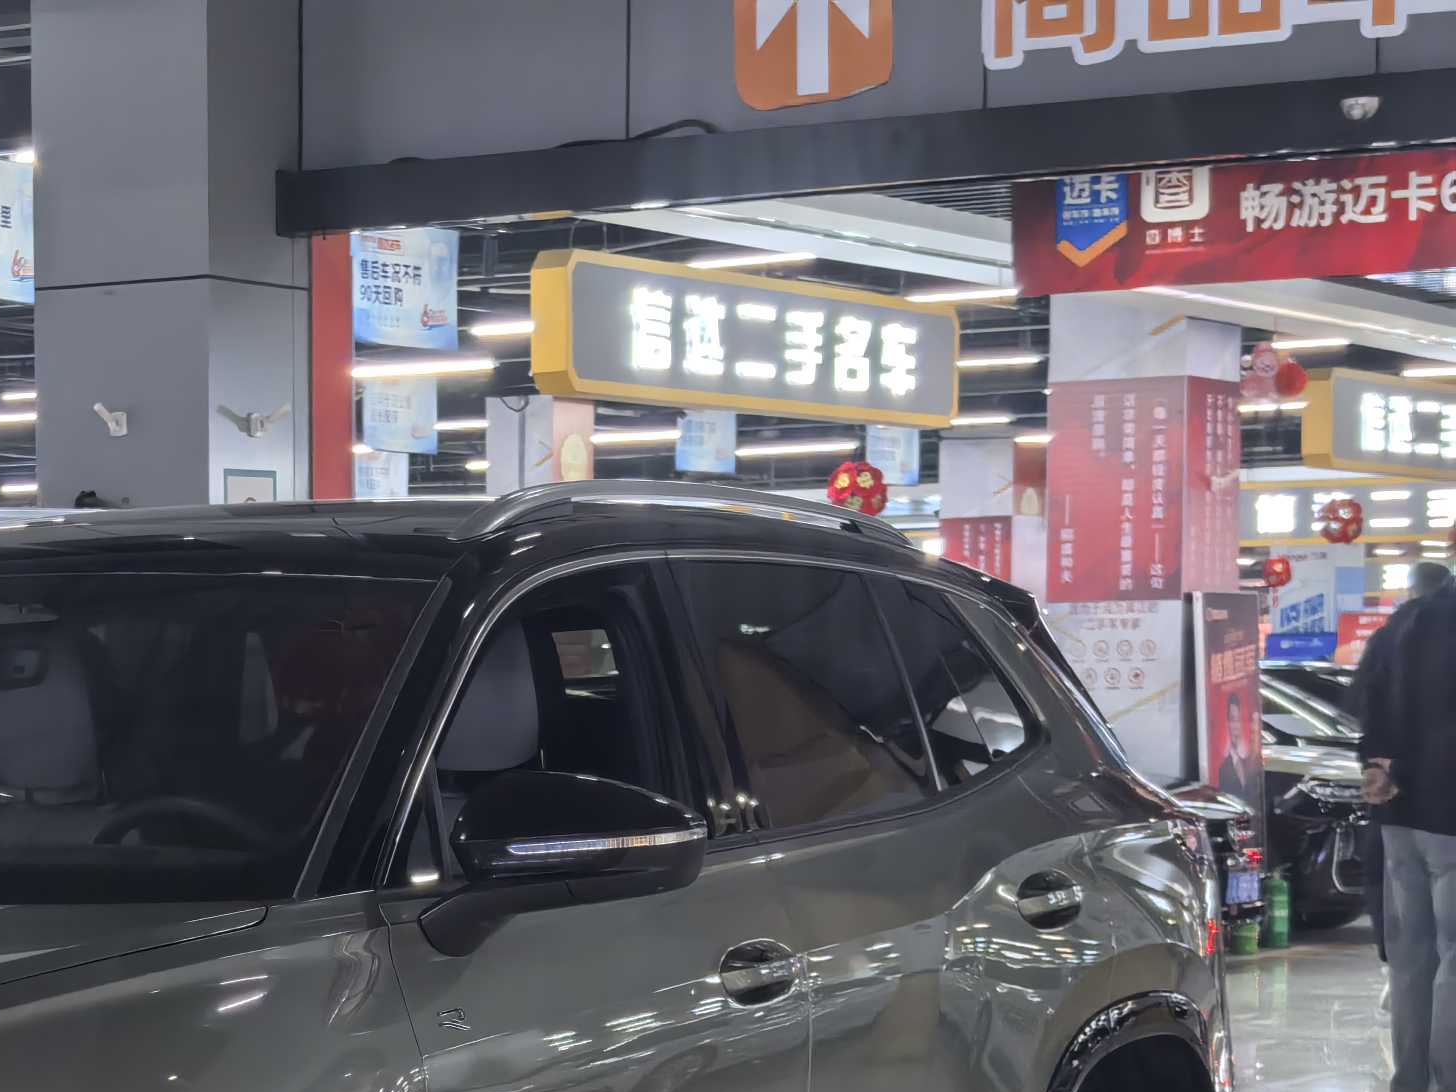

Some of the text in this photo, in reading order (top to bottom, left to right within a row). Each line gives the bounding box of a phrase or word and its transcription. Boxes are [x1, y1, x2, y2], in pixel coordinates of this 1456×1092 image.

[629, 286, 918, 396] 信达二手名车
